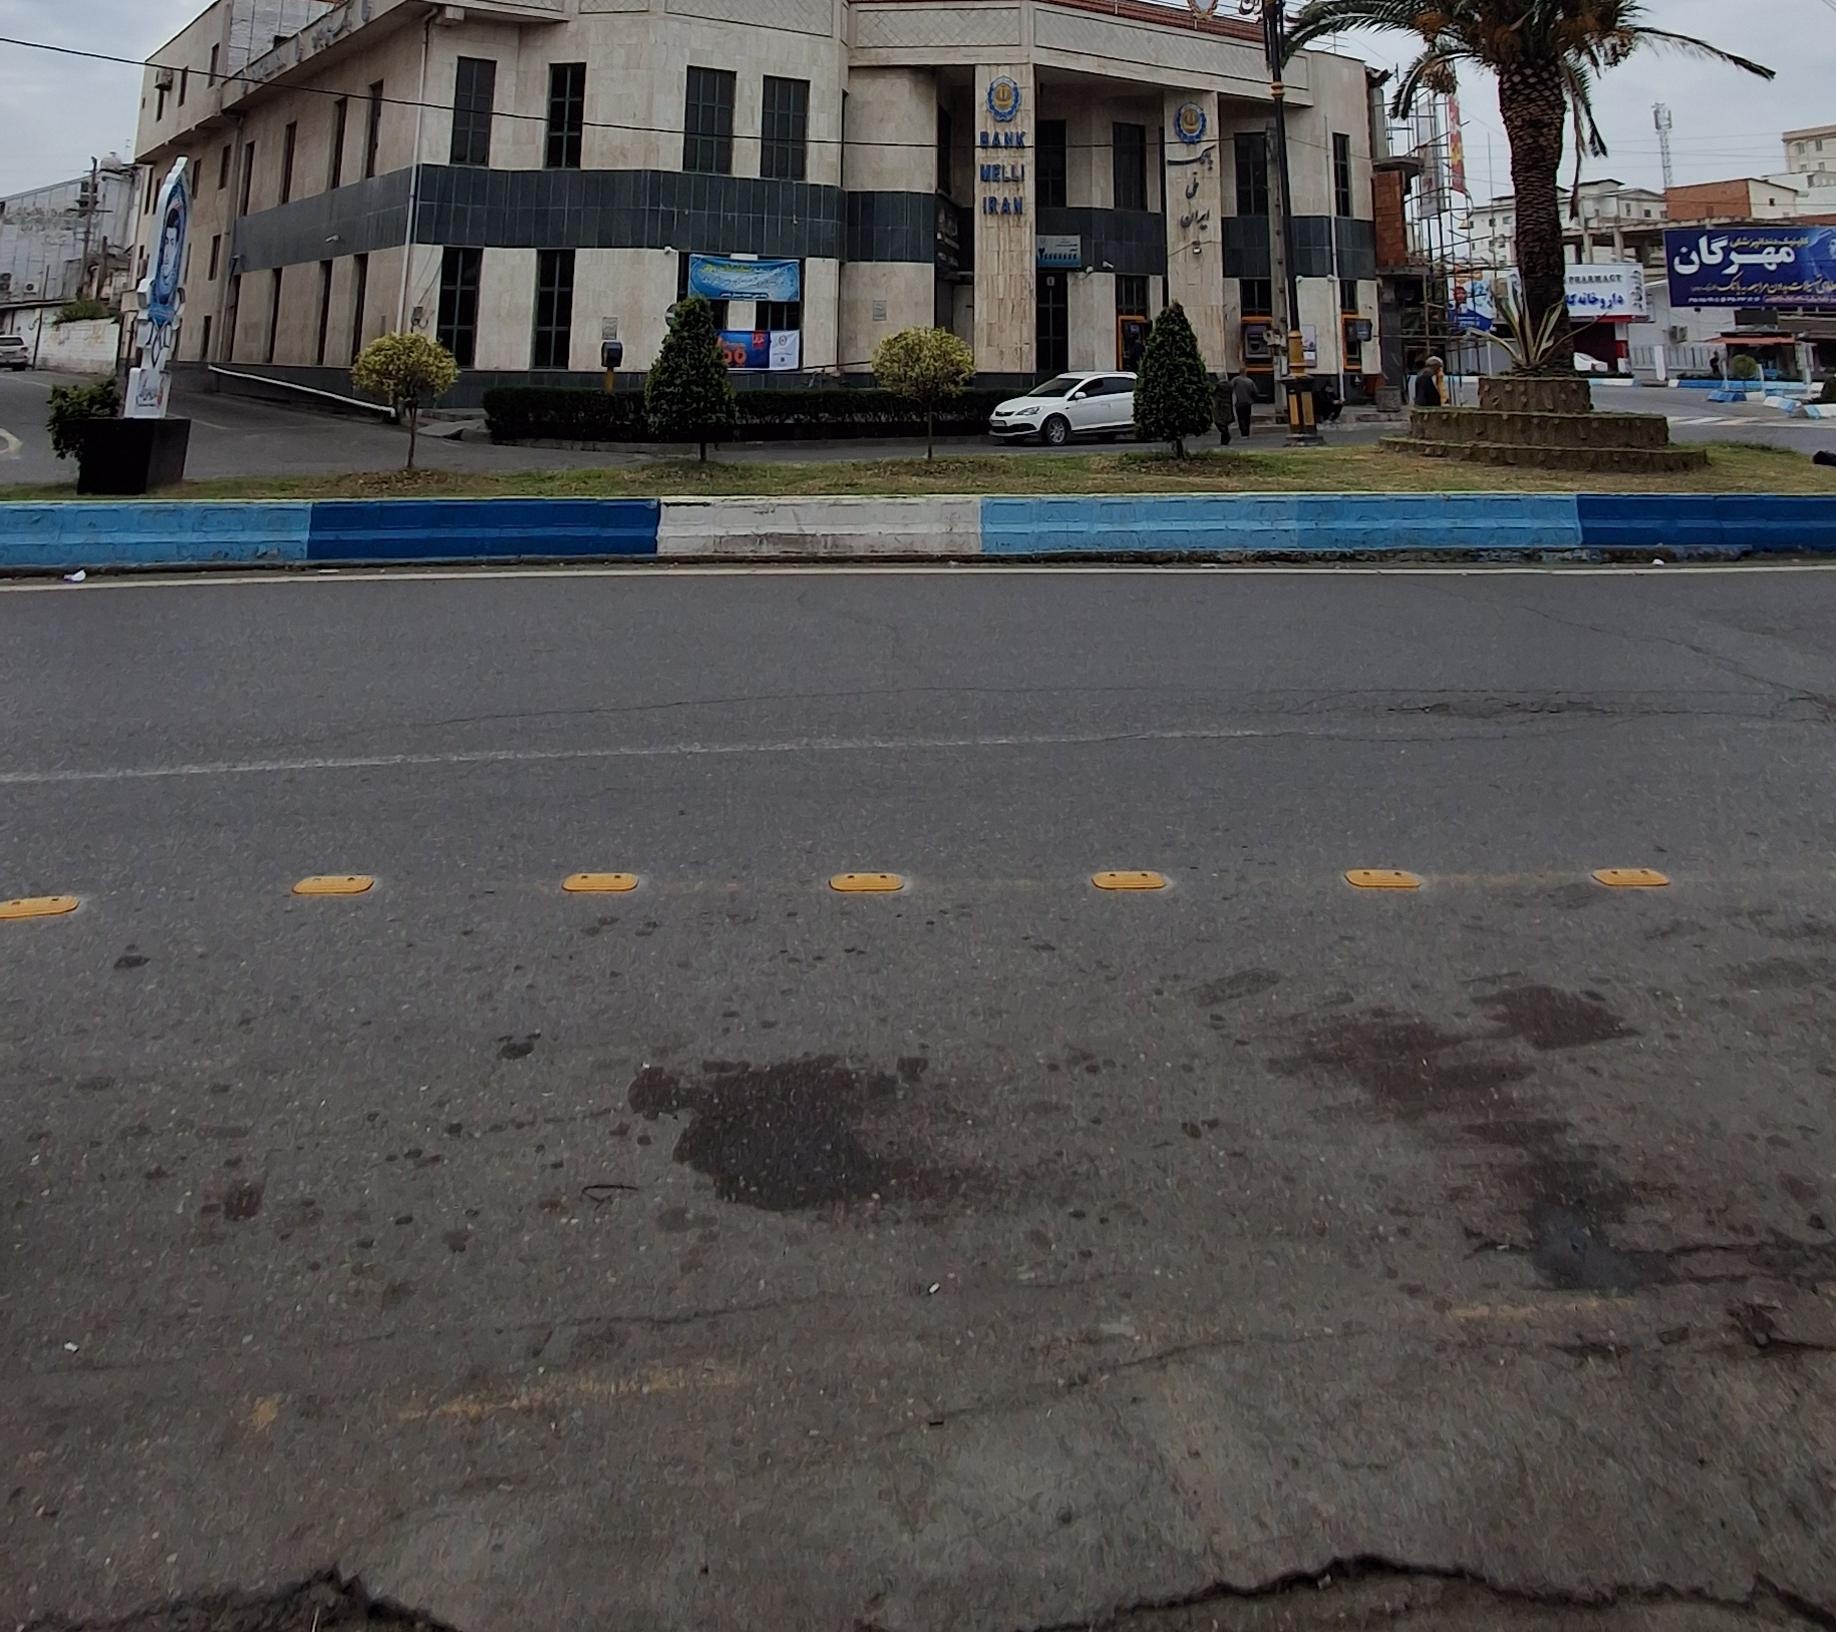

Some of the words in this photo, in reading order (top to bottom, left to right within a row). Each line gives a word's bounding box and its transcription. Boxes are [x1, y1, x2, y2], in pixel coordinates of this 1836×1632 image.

[979, 131, 1026, 149] BANK
[1167, 144, 1217, 171] بانک
[979, 164, 1025, 183] MELLI
[983, 196, 1023, 215] IRAN
[1180, 209, 1210, 231] ایران
[1673, 235, 1796, 275] مهرگان
[1568, 274, 1622, 285] PHARMACY
[1578, 292, 1624, 309] داروخانه
